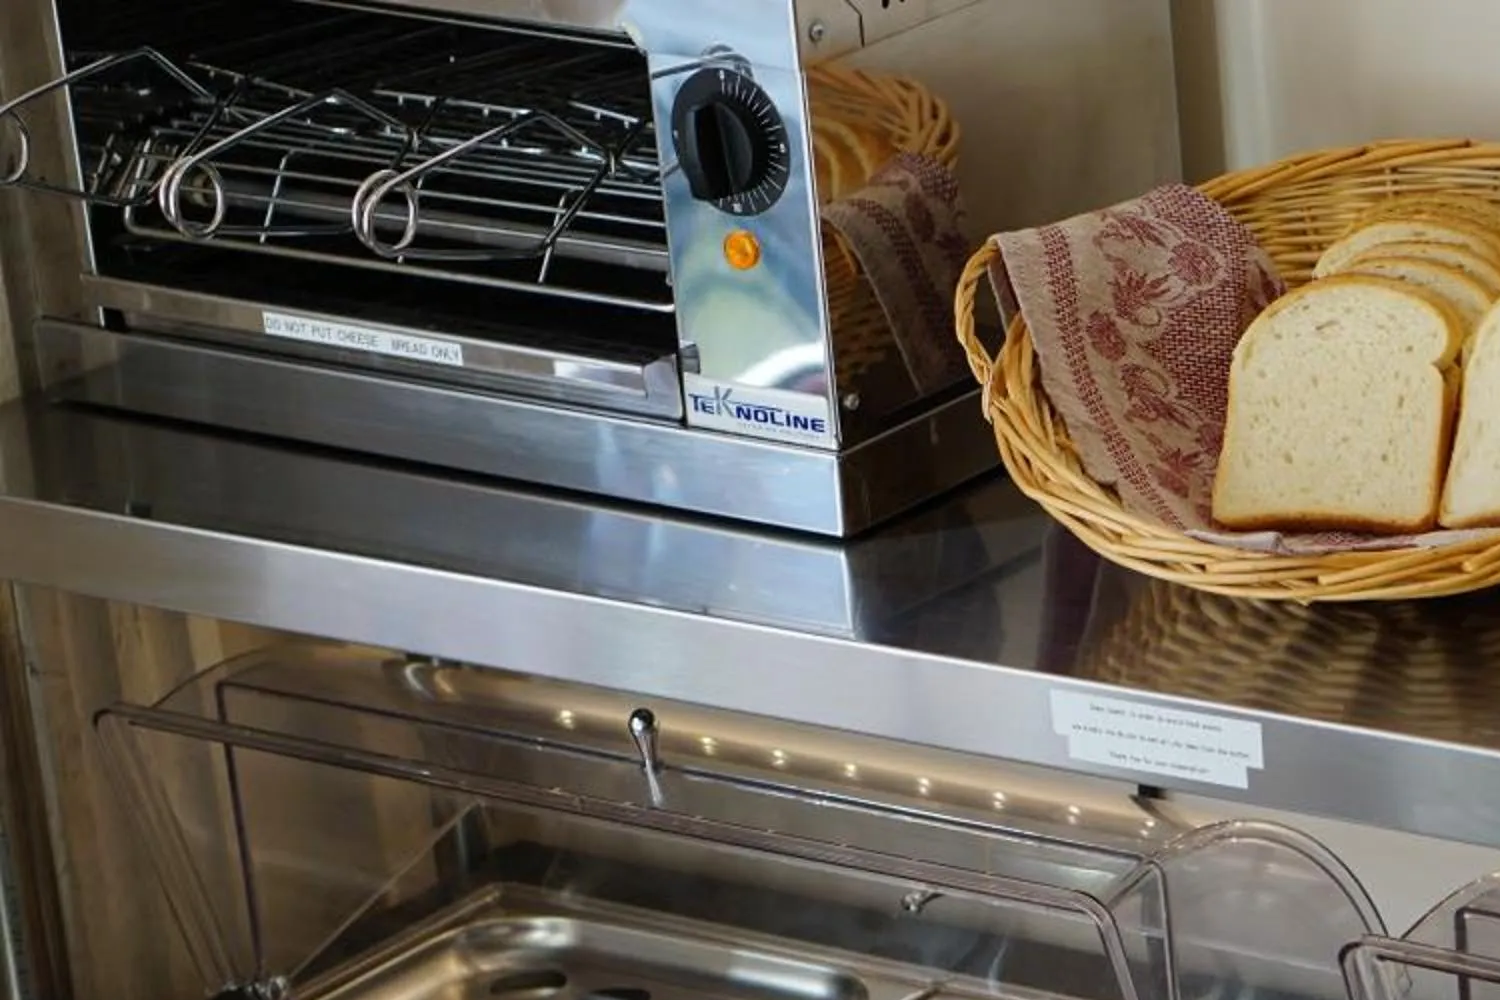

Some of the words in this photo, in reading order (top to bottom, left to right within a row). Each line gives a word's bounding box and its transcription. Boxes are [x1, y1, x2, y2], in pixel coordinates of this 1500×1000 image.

[284, 319, 306, 334] NOT
[311, 324, 333, 340] PUT
[337, 328, 379, 348] CHEESE
[391, 338, 428, 356] BREAD
[431, 345, 460, 362] ONLY
